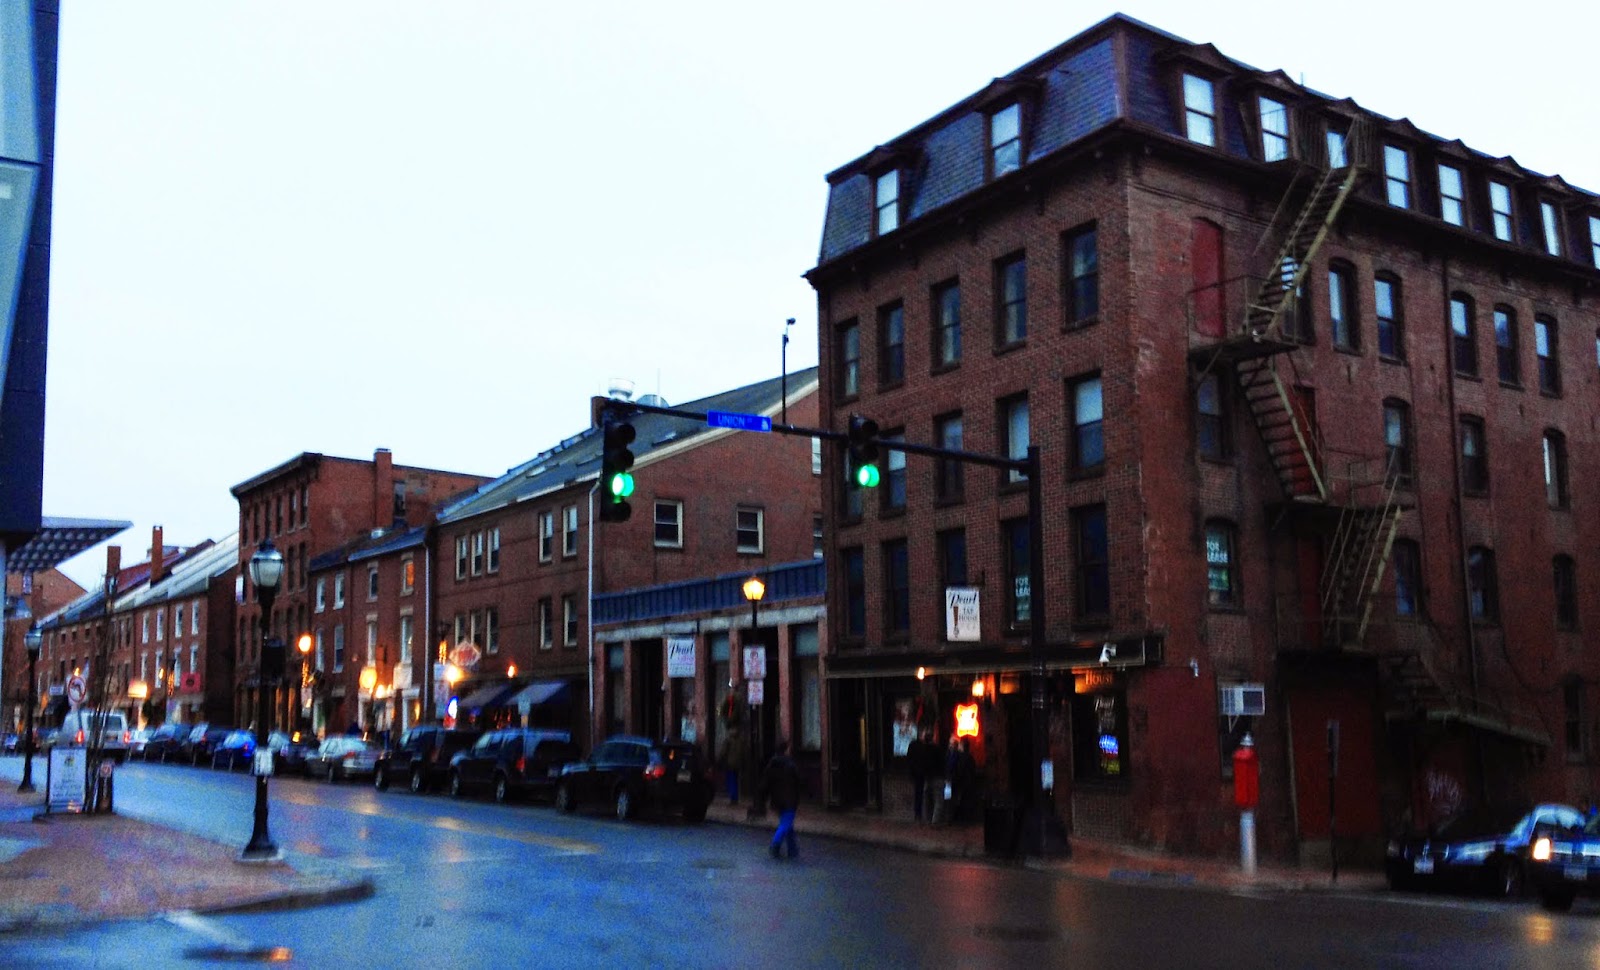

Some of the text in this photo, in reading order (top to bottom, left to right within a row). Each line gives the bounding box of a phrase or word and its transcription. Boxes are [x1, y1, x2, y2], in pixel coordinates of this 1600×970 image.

[718, 414, 745, 428] UNION
[1206, 541, 1220, 552] FOR
[1206, 552, 1229, 563] LEASE
[949, 591, 977, 608] Pearl
